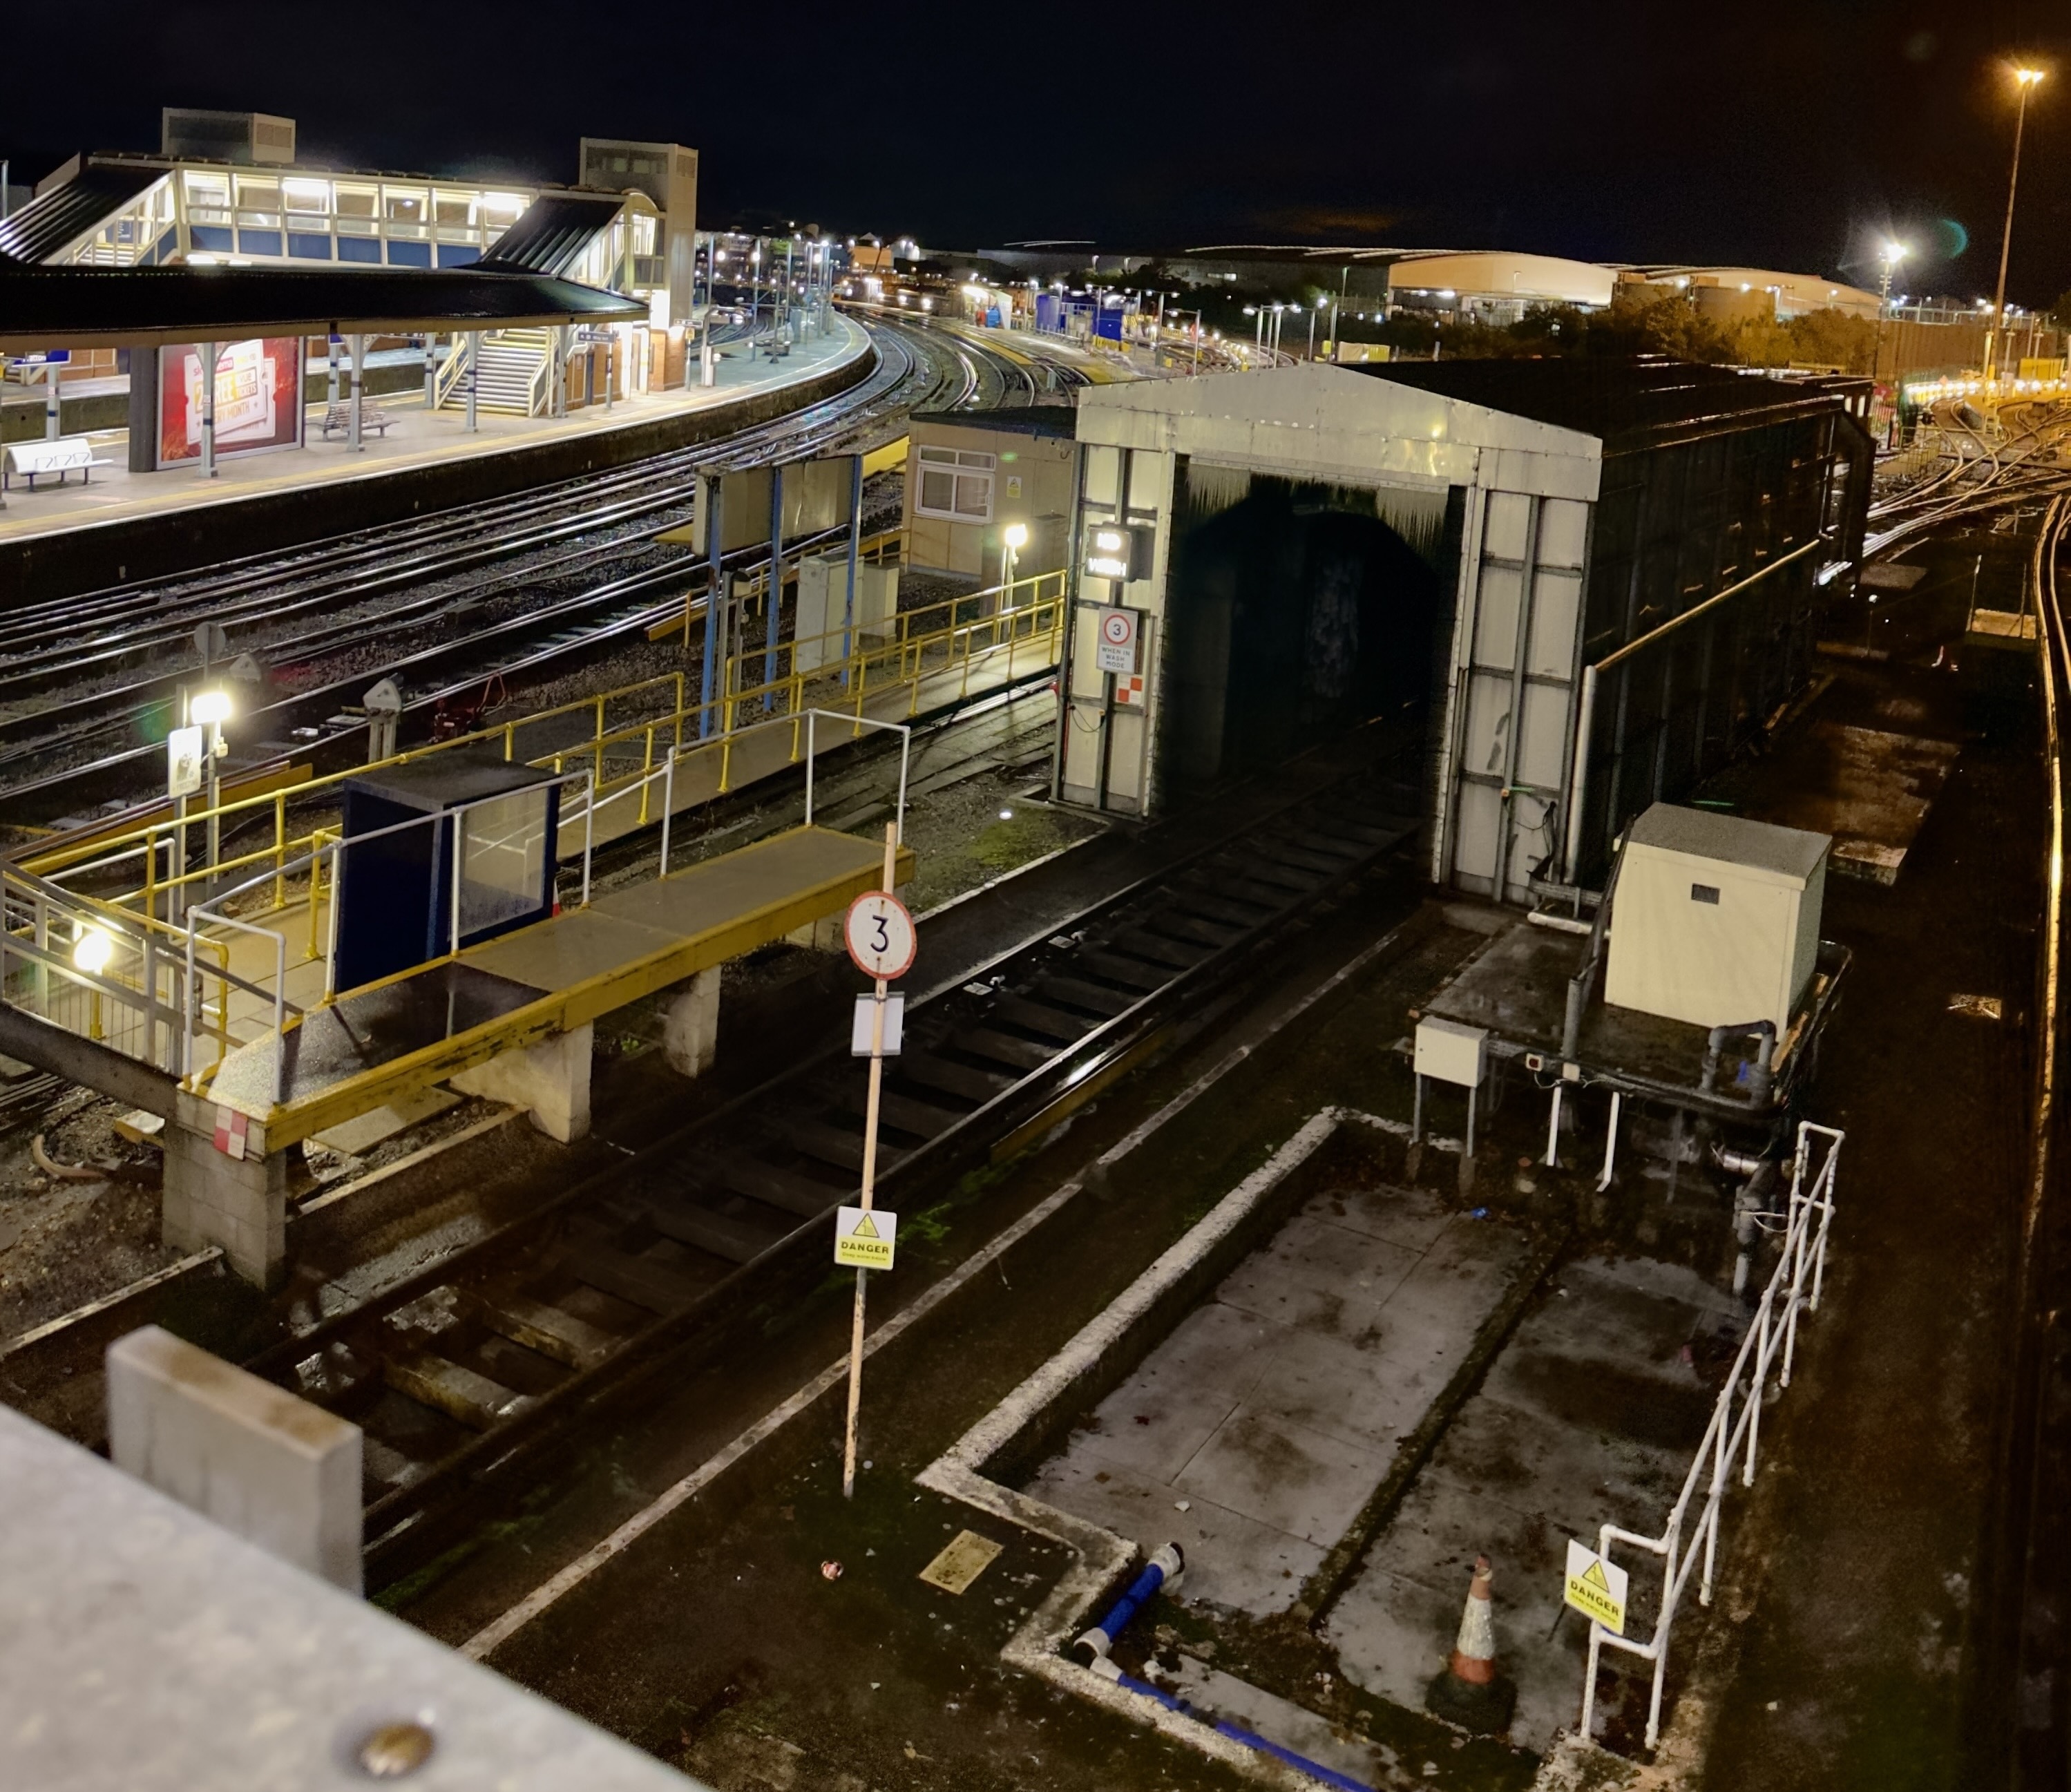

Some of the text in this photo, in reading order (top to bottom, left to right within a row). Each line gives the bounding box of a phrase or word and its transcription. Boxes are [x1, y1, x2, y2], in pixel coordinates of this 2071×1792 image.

[216, 376, 233, 403] REE
[228, 401, 250, 419] MONTH
[1113, 624, 1122, 636] 3
[1101, 647, 1120, 655] WHEN
[870, 914, 889, 953] 3
[841, 1241, 889, 1255] DANGER
[1570, 1580, 1619, 1617] DANGER
